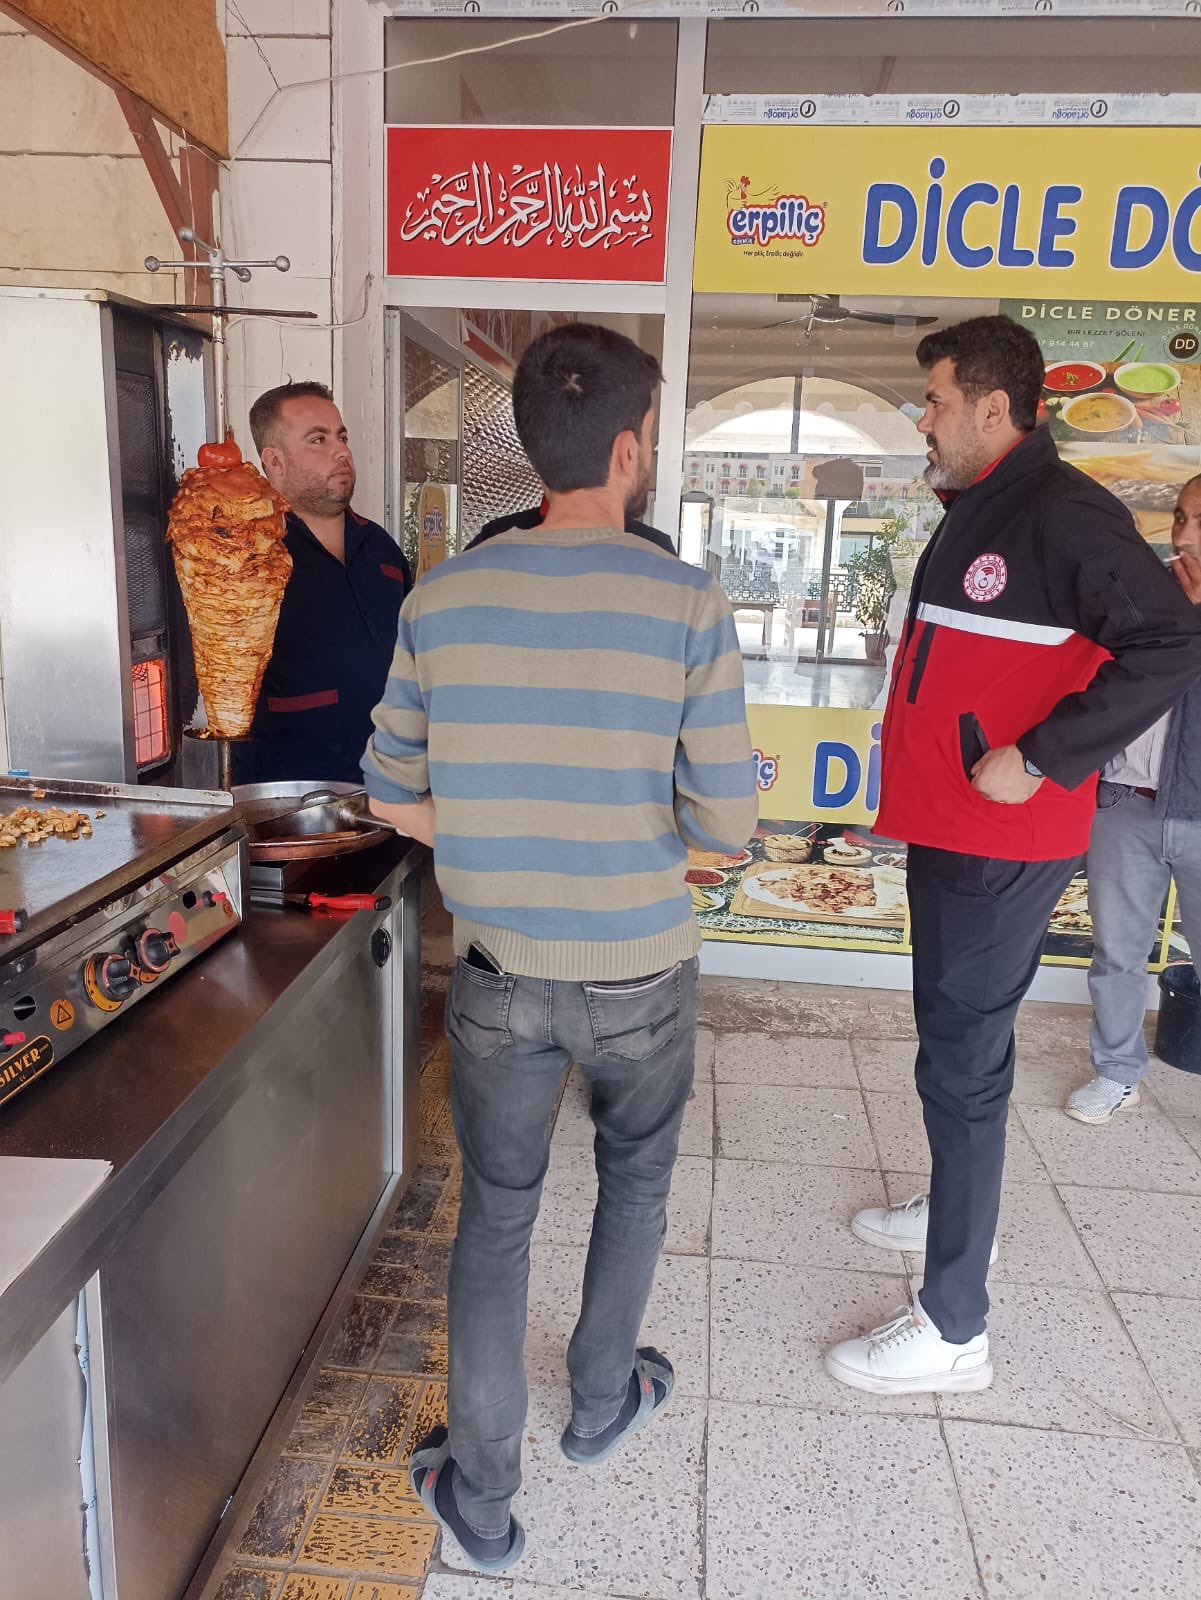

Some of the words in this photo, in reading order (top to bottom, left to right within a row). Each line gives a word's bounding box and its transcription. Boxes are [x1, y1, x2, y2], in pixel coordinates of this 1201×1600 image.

[861, 156, 1083, 270] DİCLE
[730, 199, 822, 243] erpiliç
[1021, 304, 1093, 320] DİCLE
[1105, 305, 1197, 322] DÖNER
[1083, 329, 1113, 337] LEZZET
[1069, 340, 1081, 348] 44
[1175, 338, 1197, 350] DD
